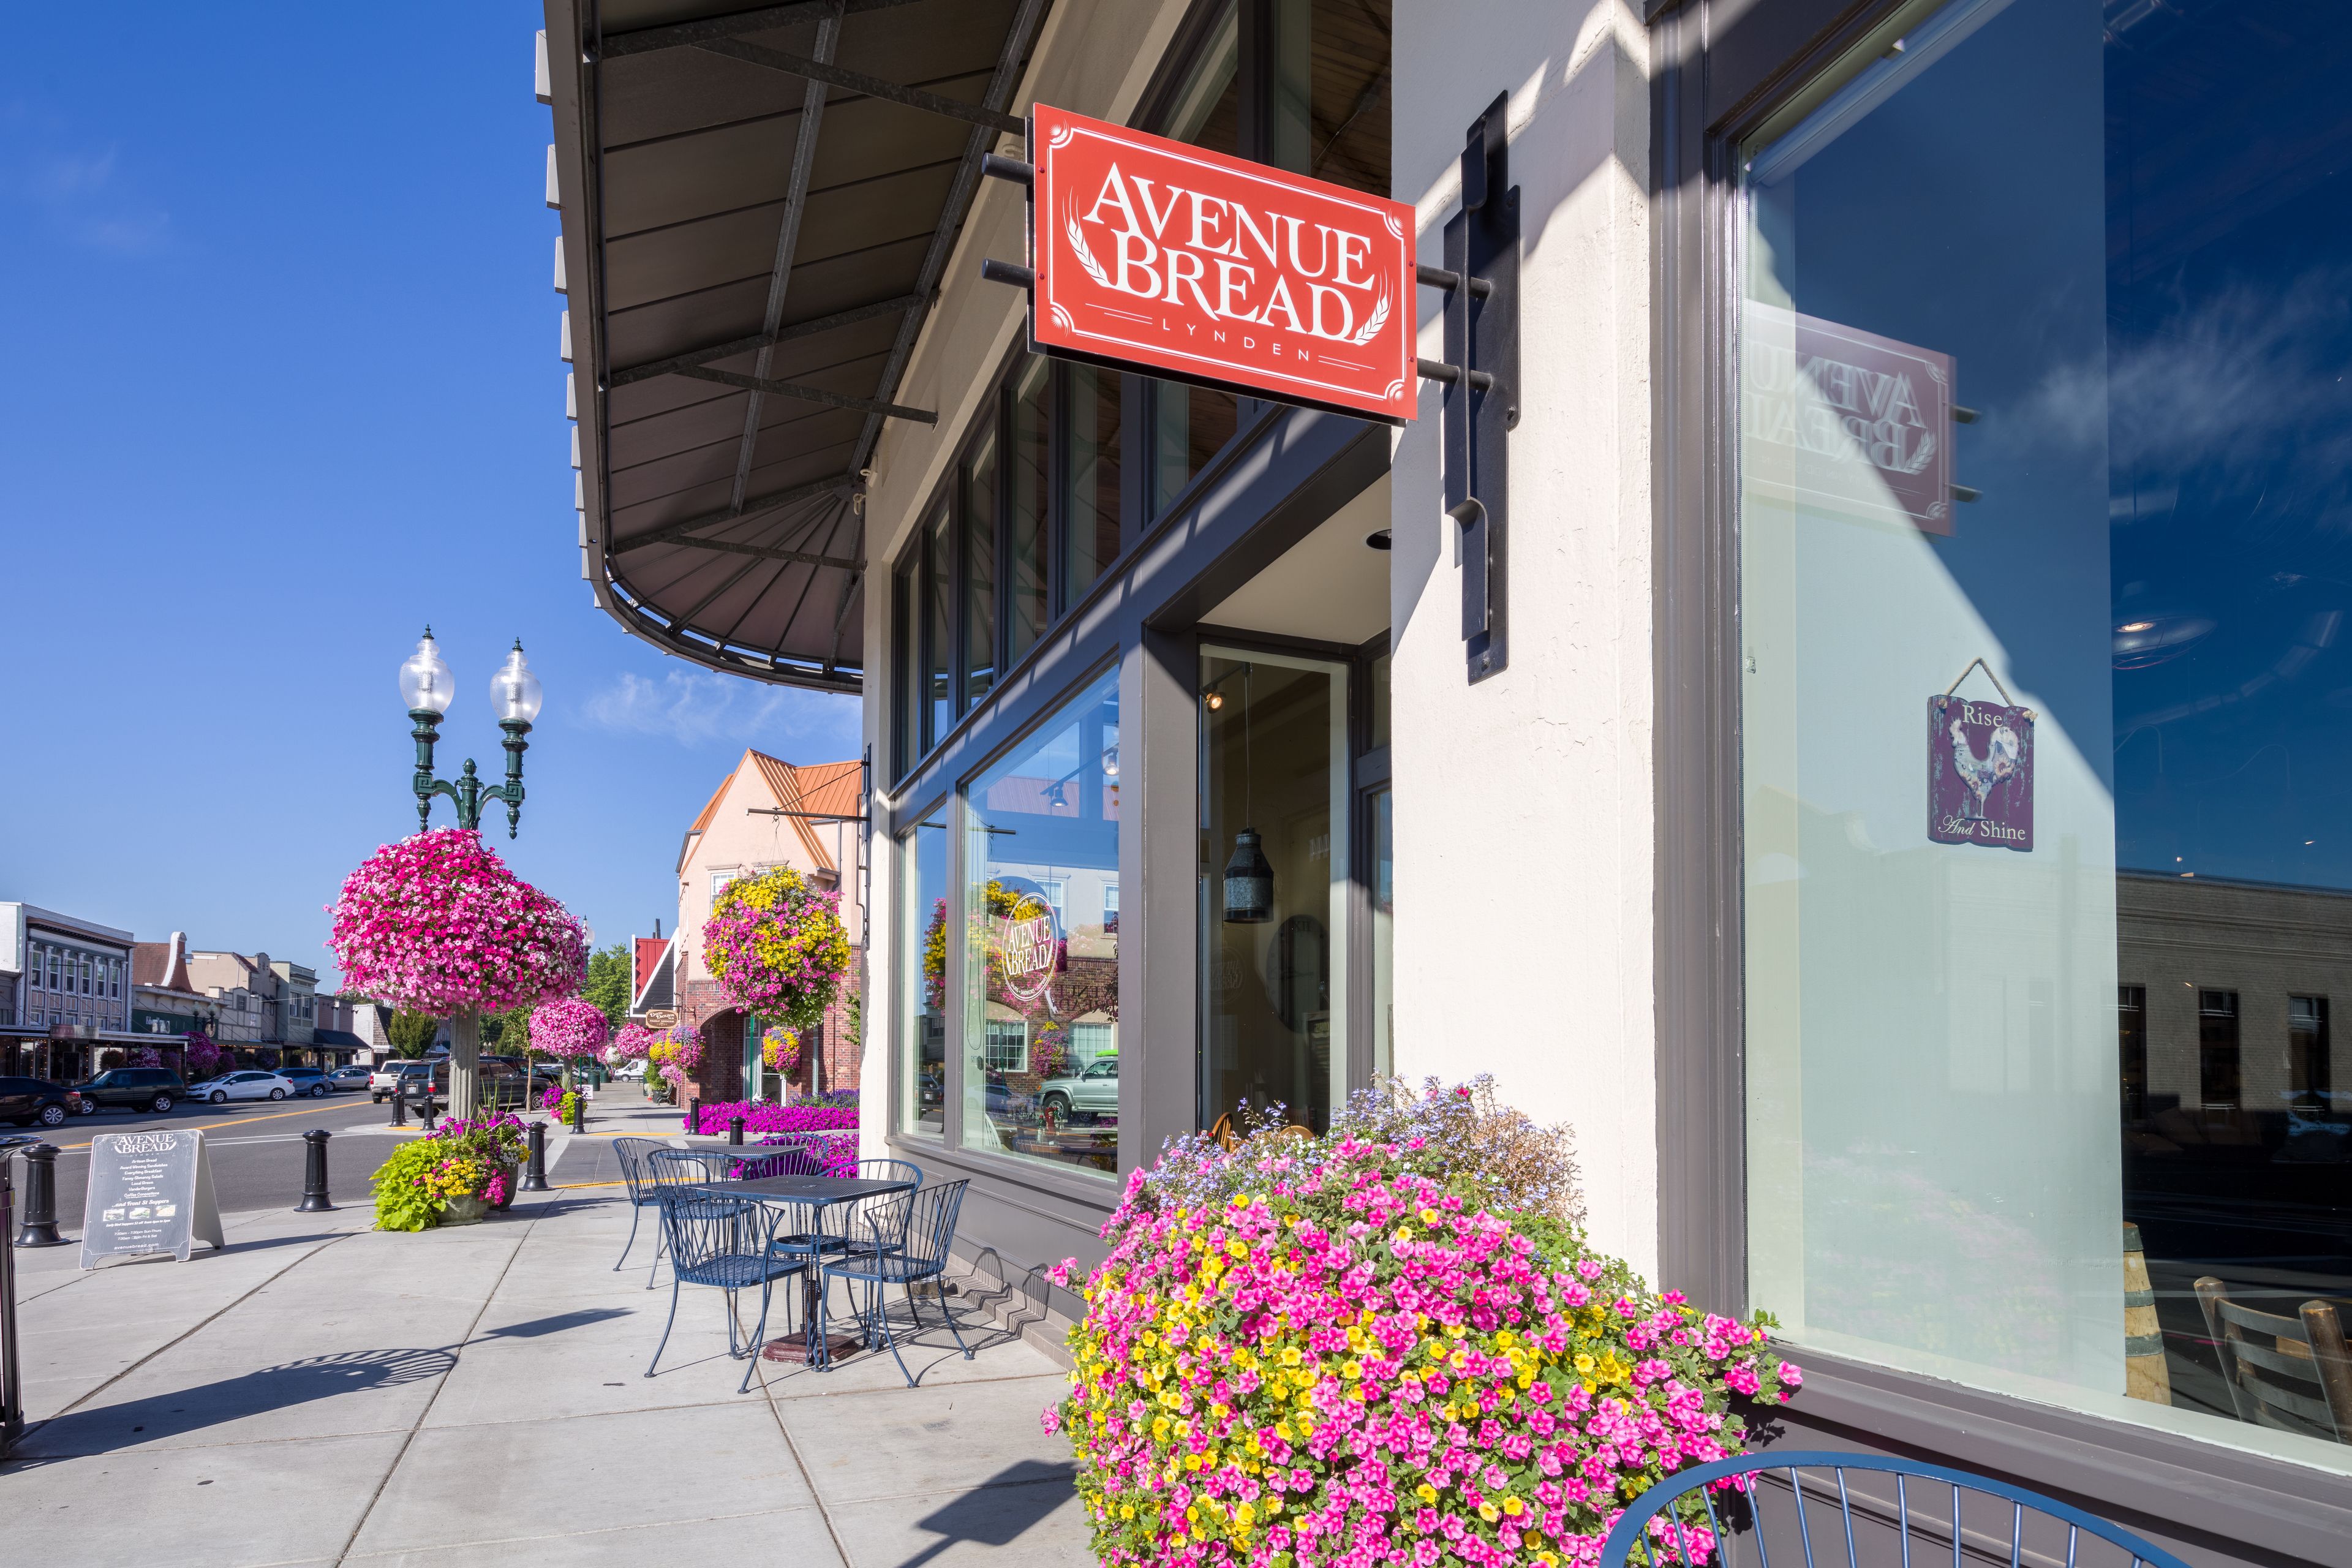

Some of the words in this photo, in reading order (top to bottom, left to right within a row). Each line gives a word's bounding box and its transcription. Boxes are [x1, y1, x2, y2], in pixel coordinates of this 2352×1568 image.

[1082, 162, 1375, 291] AVENUE
[1110, 228, 1354, 341] BREAD
[1163, 318, 1310, 361] LYNDEN
[1962, 704, 2003, 728] Rise
[1938, 815, 1974, 836] And
[1980, 820, 2026, 840] Shine
[1008, 916, 1050, 951] AVENUE
[1011, 944, 1047, 975] BREAD
[118, 1134, 174, 1145] AVENUE
[123, 1142, 170, 1153] BREAD
